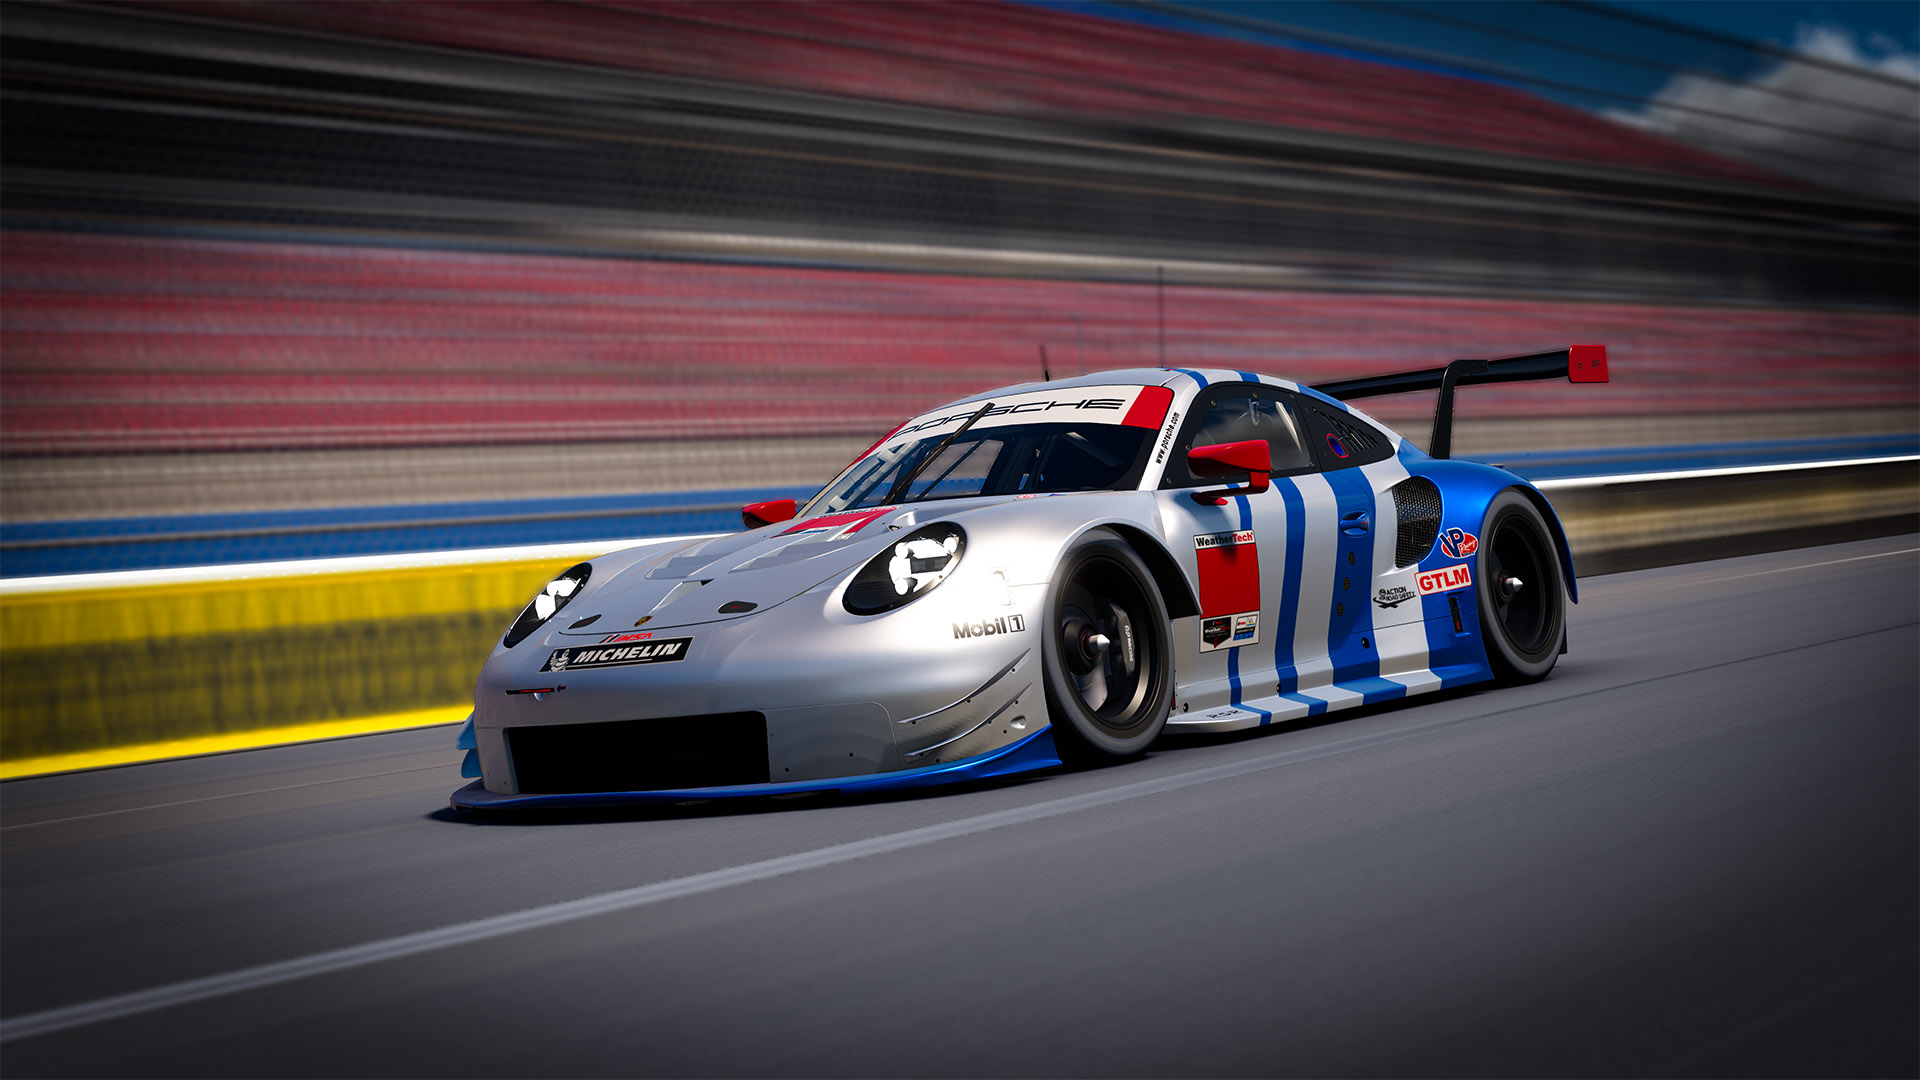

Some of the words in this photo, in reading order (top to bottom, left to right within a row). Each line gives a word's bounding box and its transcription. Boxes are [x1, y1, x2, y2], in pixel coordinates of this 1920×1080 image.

[887, 398, 1126, 443] PORSCHE
[1386, 586, 1407, 596] ACTION
[1419, 567, 1470, 591] GTLM
[952, 617, 1008, 639] Mobil
[1010, 615, 1023, 631] 1
[573, 643, 682, 663] MICHELIN
